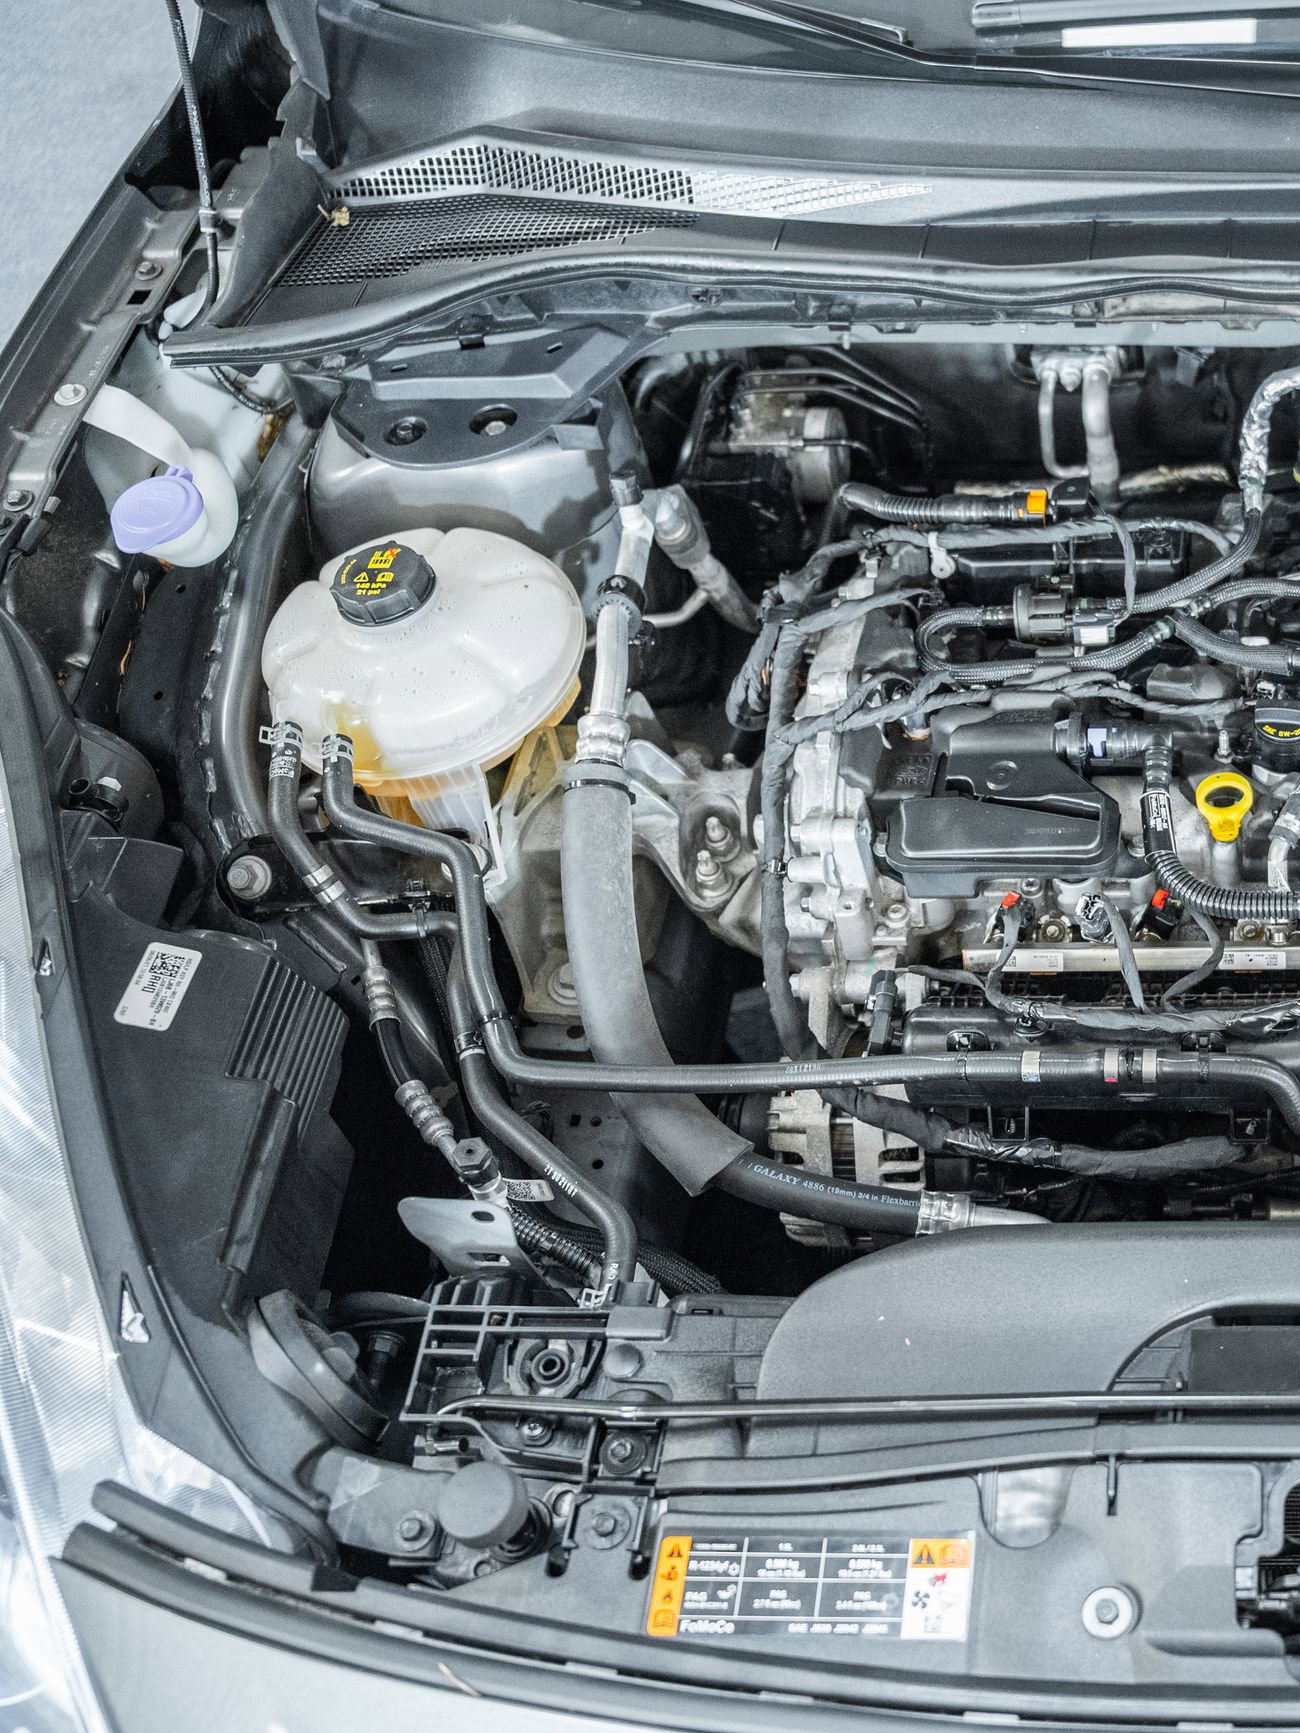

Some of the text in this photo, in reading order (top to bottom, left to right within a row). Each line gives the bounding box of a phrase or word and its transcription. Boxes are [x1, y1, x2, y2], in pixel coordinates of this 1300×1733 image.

[1262, 724, 1277, 735] SAE
[753, 1164, 801, 1185] GALAXY
[802, 1180, 825, 1192] 4886
[827, 1186, 857, 1199] (19mm)
[858, 1191, 870, 1200] 3/4
